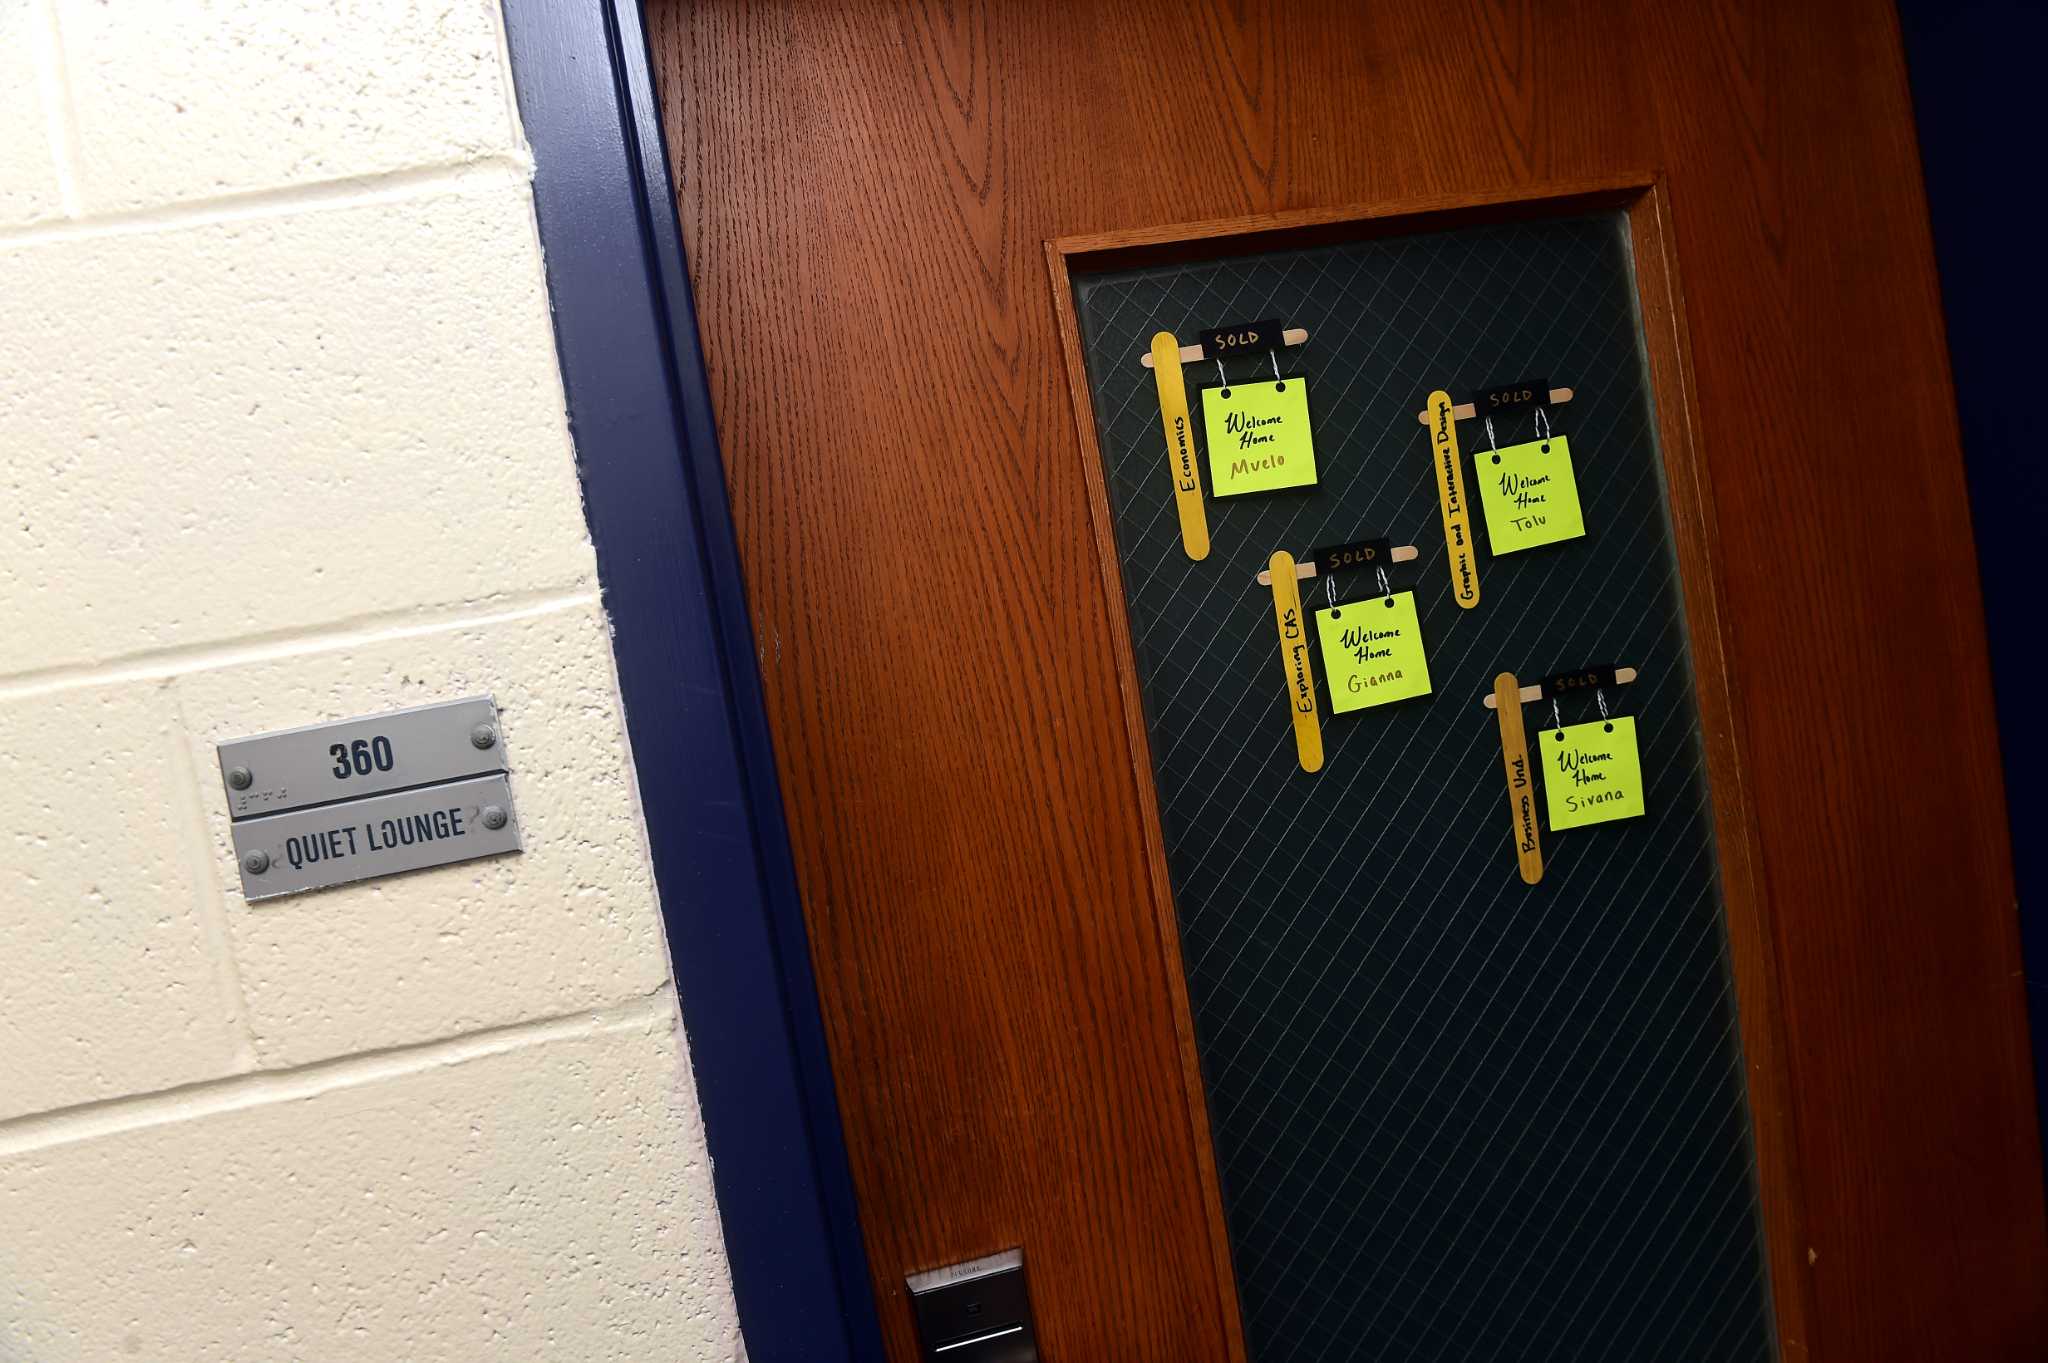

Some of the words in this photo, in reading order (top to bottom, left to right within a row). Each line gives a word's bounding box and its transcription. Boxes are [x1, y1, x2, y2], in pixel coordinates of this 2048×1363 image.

[1215, 331, 1260, 350] SOLD
[1489, 390, 1533, 407] SOLD
[1224, 410, 1283, 434] Welcome
[1437, 401, 1450, 443] Design
[1239, 431, 1275, 450] Home
[1174, 416, 1195, 492] Economics
[1443, 447, 1461, 518] Interactive
[1499, 472, 1550, 496] Welcome
[1513, 491, 1546, 509] Home
[1510, 515, 1546, 531] Tolu
[1450, 524, 1464, 546] and
[1329, 548, 1376, 568] SOLD
[1458, 553, 1474, 600] Graphic
[1284, 608, 1299, 639] CAS
[1340, 626, 1401, 648] Welcome
[1354, 646, 1392, 664] Home
[1292, 645, 1312, 713] Exploring
[1348, 670, 1403, 692] Gianna
[1555, 673, 1599, 691] SOLD
[329, 735, 394, 779] 360
[1557, 749, 1613, 772] Welcome
[1572, 769, 1606, 788] Home
[1565, 789, 1624, 812] Sivana
[1522, 795, 1536, 853] Business
[286, 827, 356, 870] QUIET
[367, 808, 466, 851] LOUNGE
